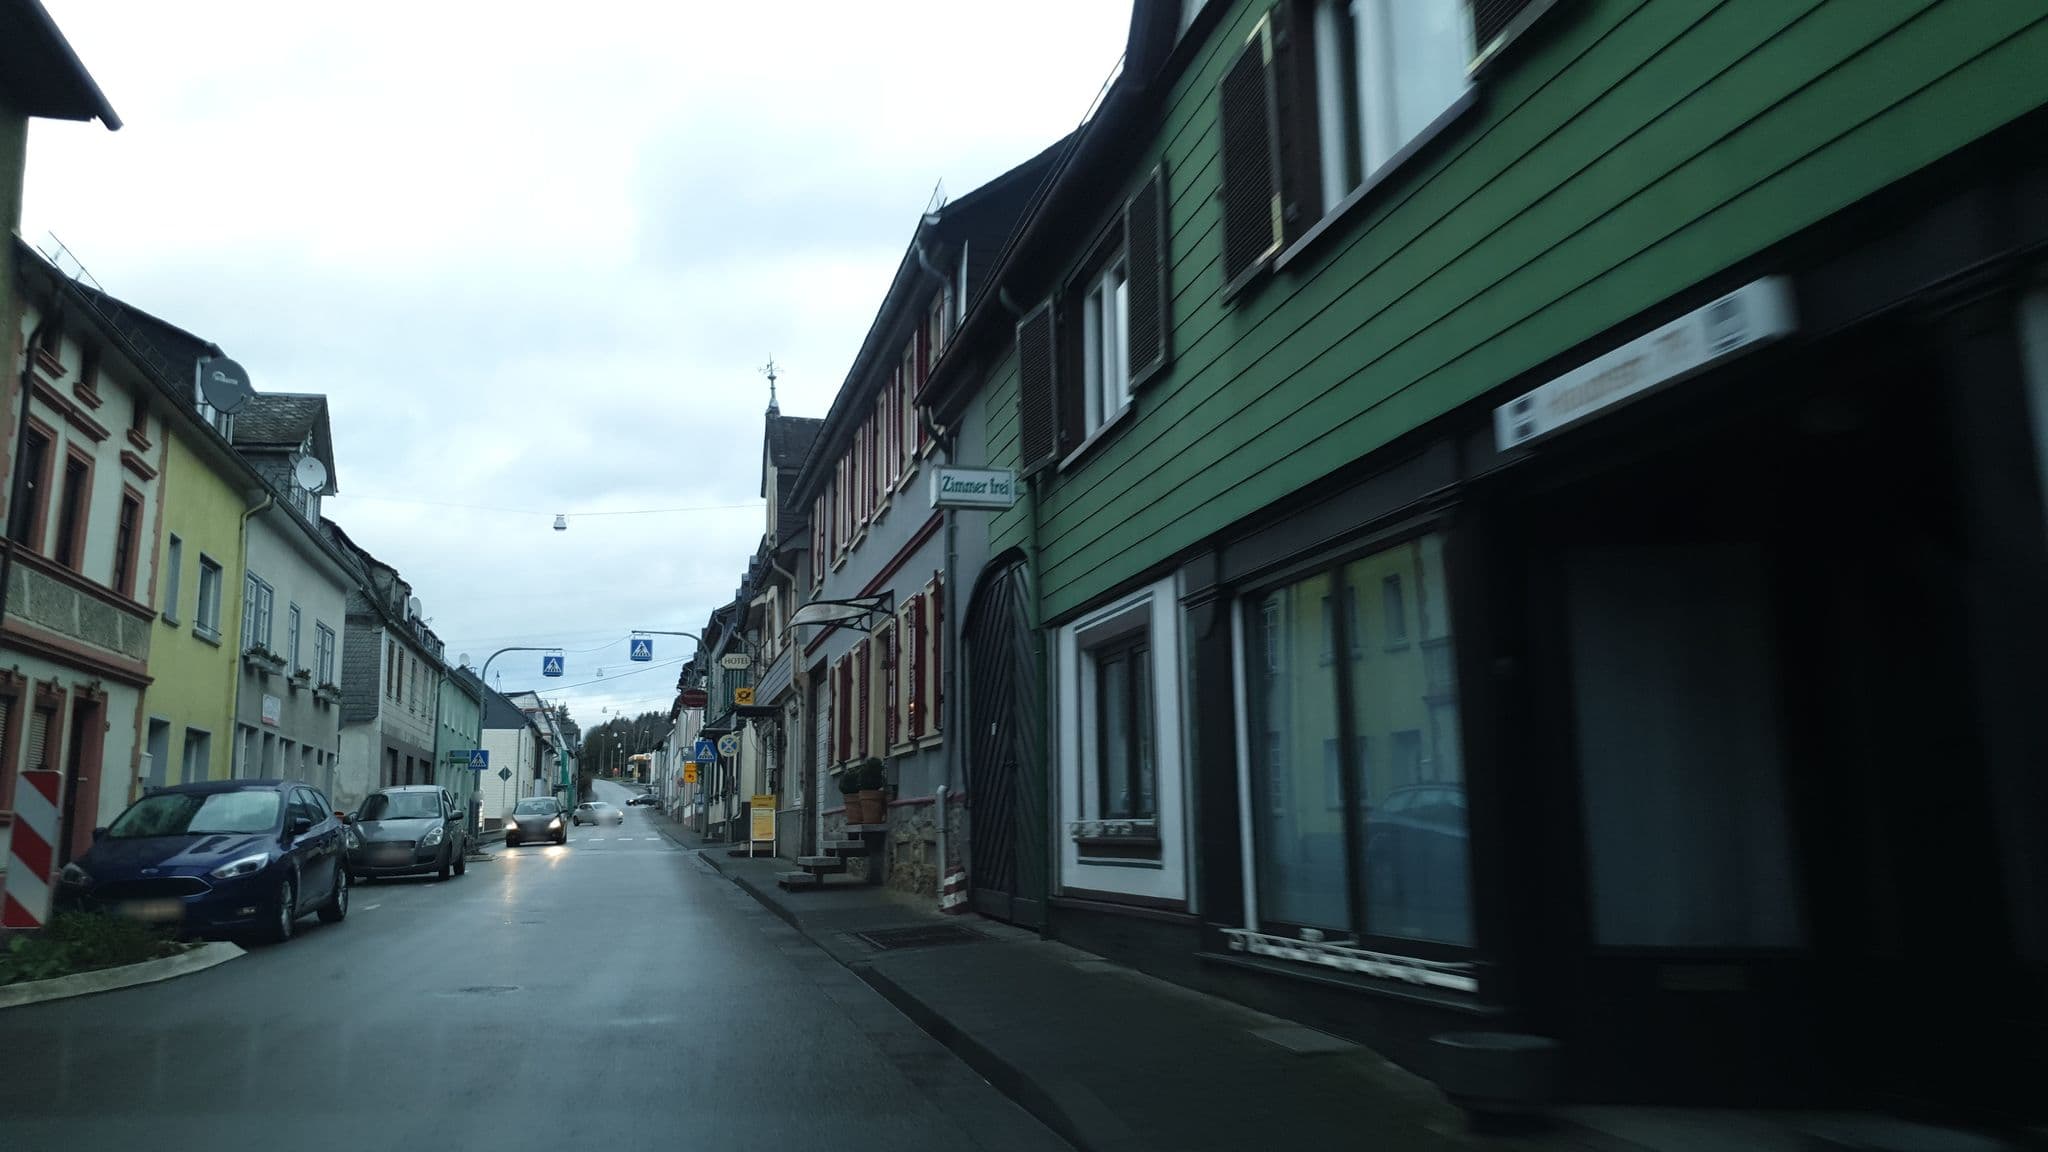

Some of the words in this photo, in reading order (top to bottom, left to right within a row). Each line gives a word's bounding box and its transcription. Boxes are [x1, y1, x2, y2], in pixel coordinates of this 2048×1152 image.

[942, 475, 987, 494] Zimmer
[990, 477, 1009, 496] frei
[724, 657, 749, 665] HOTEL
